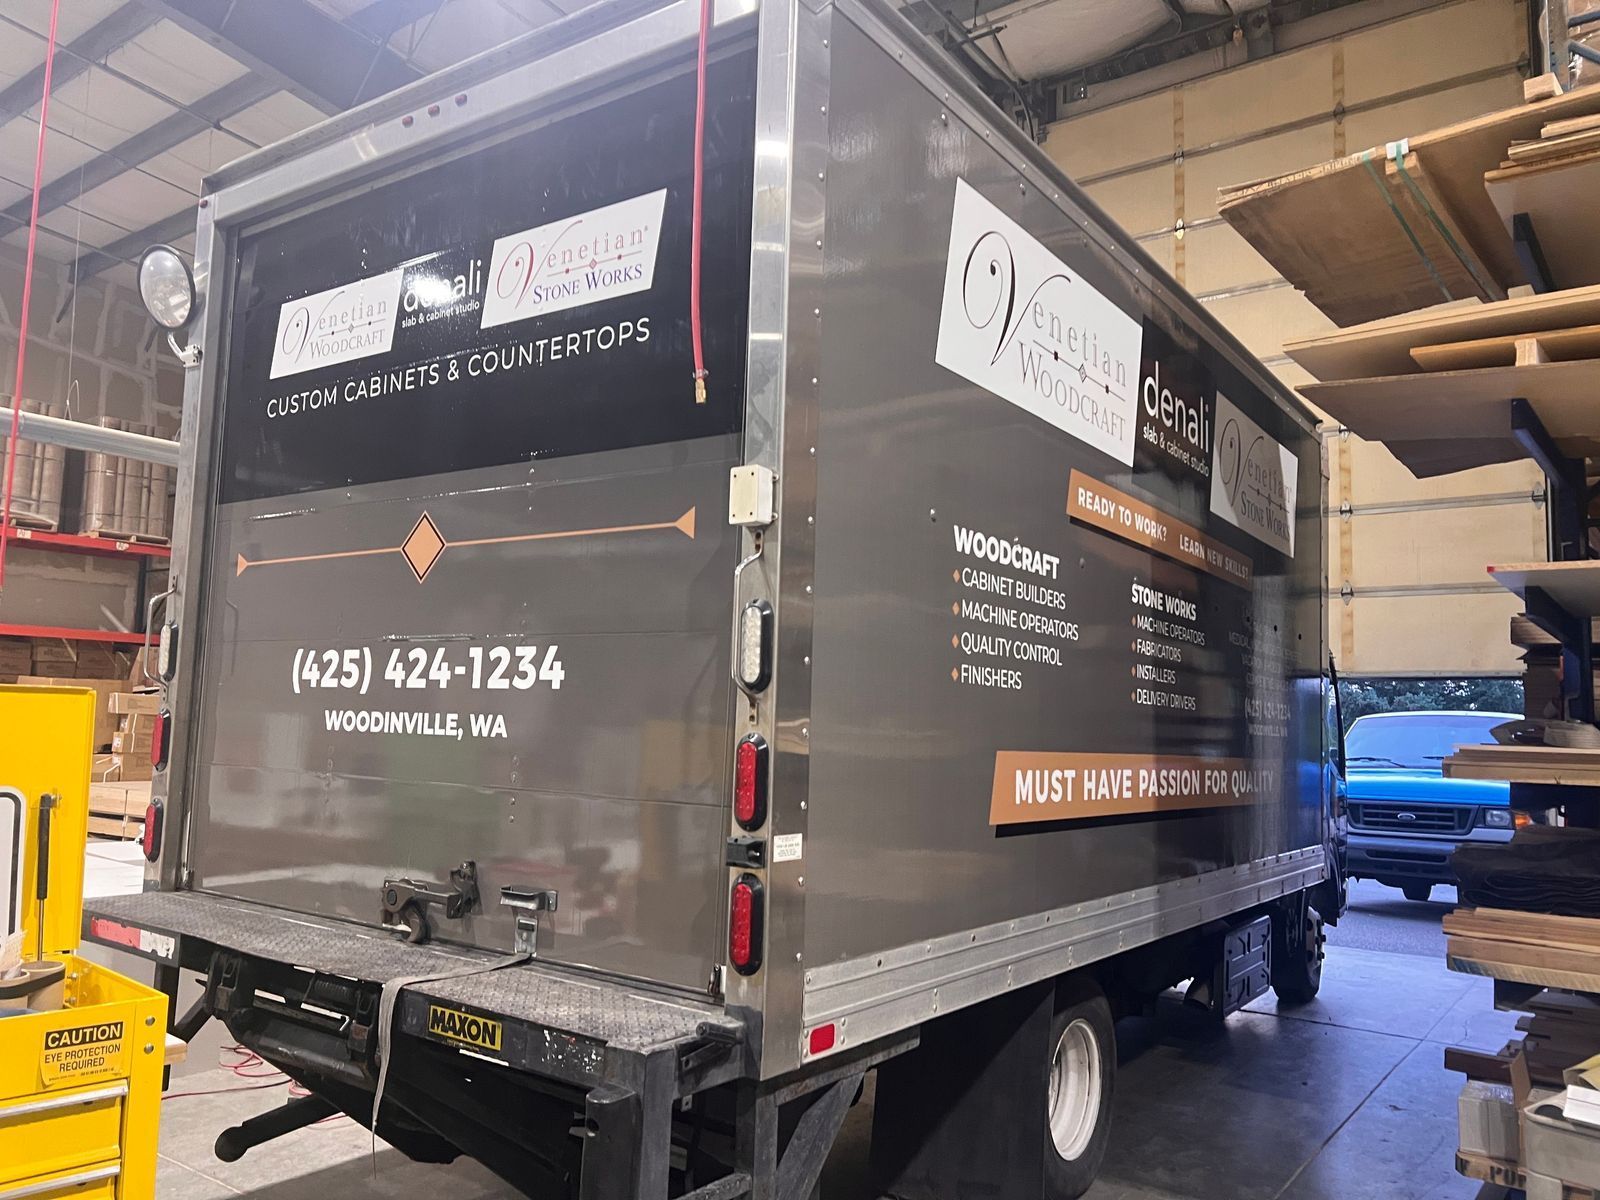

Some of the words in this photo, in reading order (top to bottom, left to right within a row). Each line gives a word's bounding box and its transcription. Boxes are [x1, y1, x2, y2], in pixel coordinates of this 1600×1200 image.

[533, 279, 580, 304] STONE
[585, 264, 642, 291] WORKS
[282, 290, 387, 364] Venetian
[401, 314, 417, 328] slab
[418, 312, 425, 324] &
[426, 307, 454, 322] cabinet
[455, 299, 480, 315] studio
[962, 231, 1127, 388] Venetian
[309, 329, 386, 359] WOODCRAFT
[266, 385, 338, 418] CUSTOM
[344, 363, 439, 402] CABINETS
[447, 359, 460, 381] &
[468, 317, 650, 377] COUNTERTOPS
[1017, 340, 1126, 442] WOODCRAFT
[1143, 360, 1209, 453] denali
[1143, 422, 1158, 445] slab
[1159, 432, 1165, 450] &
[1166, 437, 1190, 466] cabinet
[1191, 458, 1209, 477] studio
[1078, 487, 1115, 520] READY
[1118, 504, 1131, 527] TO
[1134, 511, 1167, 542] WORK?
[1179, 533, 1205, 560] LEARN
[1206, 546, 1224, 568] NEW
[1240, 491, 1264, 528] STONE
[1265, 508, 1291, 542] WORKS
[953, 524, 1060, 580] WOODCRAFT
[962, 567, 1014, 598] CABINET
[1015, 580, 1066, 610] BUILDERS
[1131, 583, 1163, 611] STONE
[1164, 594, 1197, 622] WORKS
[961, 599, 1018, 627] MACHINE
[1019, 613, 1079, 642] OPERATORS
[1136, 614, 1169, 636] MACHINE
[1169, 624, 1205, 646] OPERATORS
[960, 631, 1012, 656] QUALITY
[1013, 643, 1063, 667] CONTROL
[1136, 638, 1182, 663] FABRICATORS
[292, 646, 372, 695] (425)
[384, 645, 565, 690] 424-1234
[960, 663, 1022, 690] FINISHERS
[1136, 663, 1176, 685] INSTALLERS
[1136, 688, 1170, 707] DELIVERY
[1170, 695, 1196, 711] DRIVERS
[324, 710, 464, 741] WOODINVILLE,
[470, 714, 508, 738] WA
[1015, 769, 1076, 805] MUST
[1083, 768, 1132, 801] HAVE
[1139, 769, 1200, 799] PASSION
[1204, 769, 1227, 795] FOR
[1231, 769, 1274, 799] QUALITY
[47, 1023, 121, 1048] CAUTION
[430, 1008, 497, 1046] MAXON
[44, 1052, 62, 1064] EYE
[65, 1043, 121, 1061] PROTECTION
[59, 1057, 105, 1072] REQUIRED
